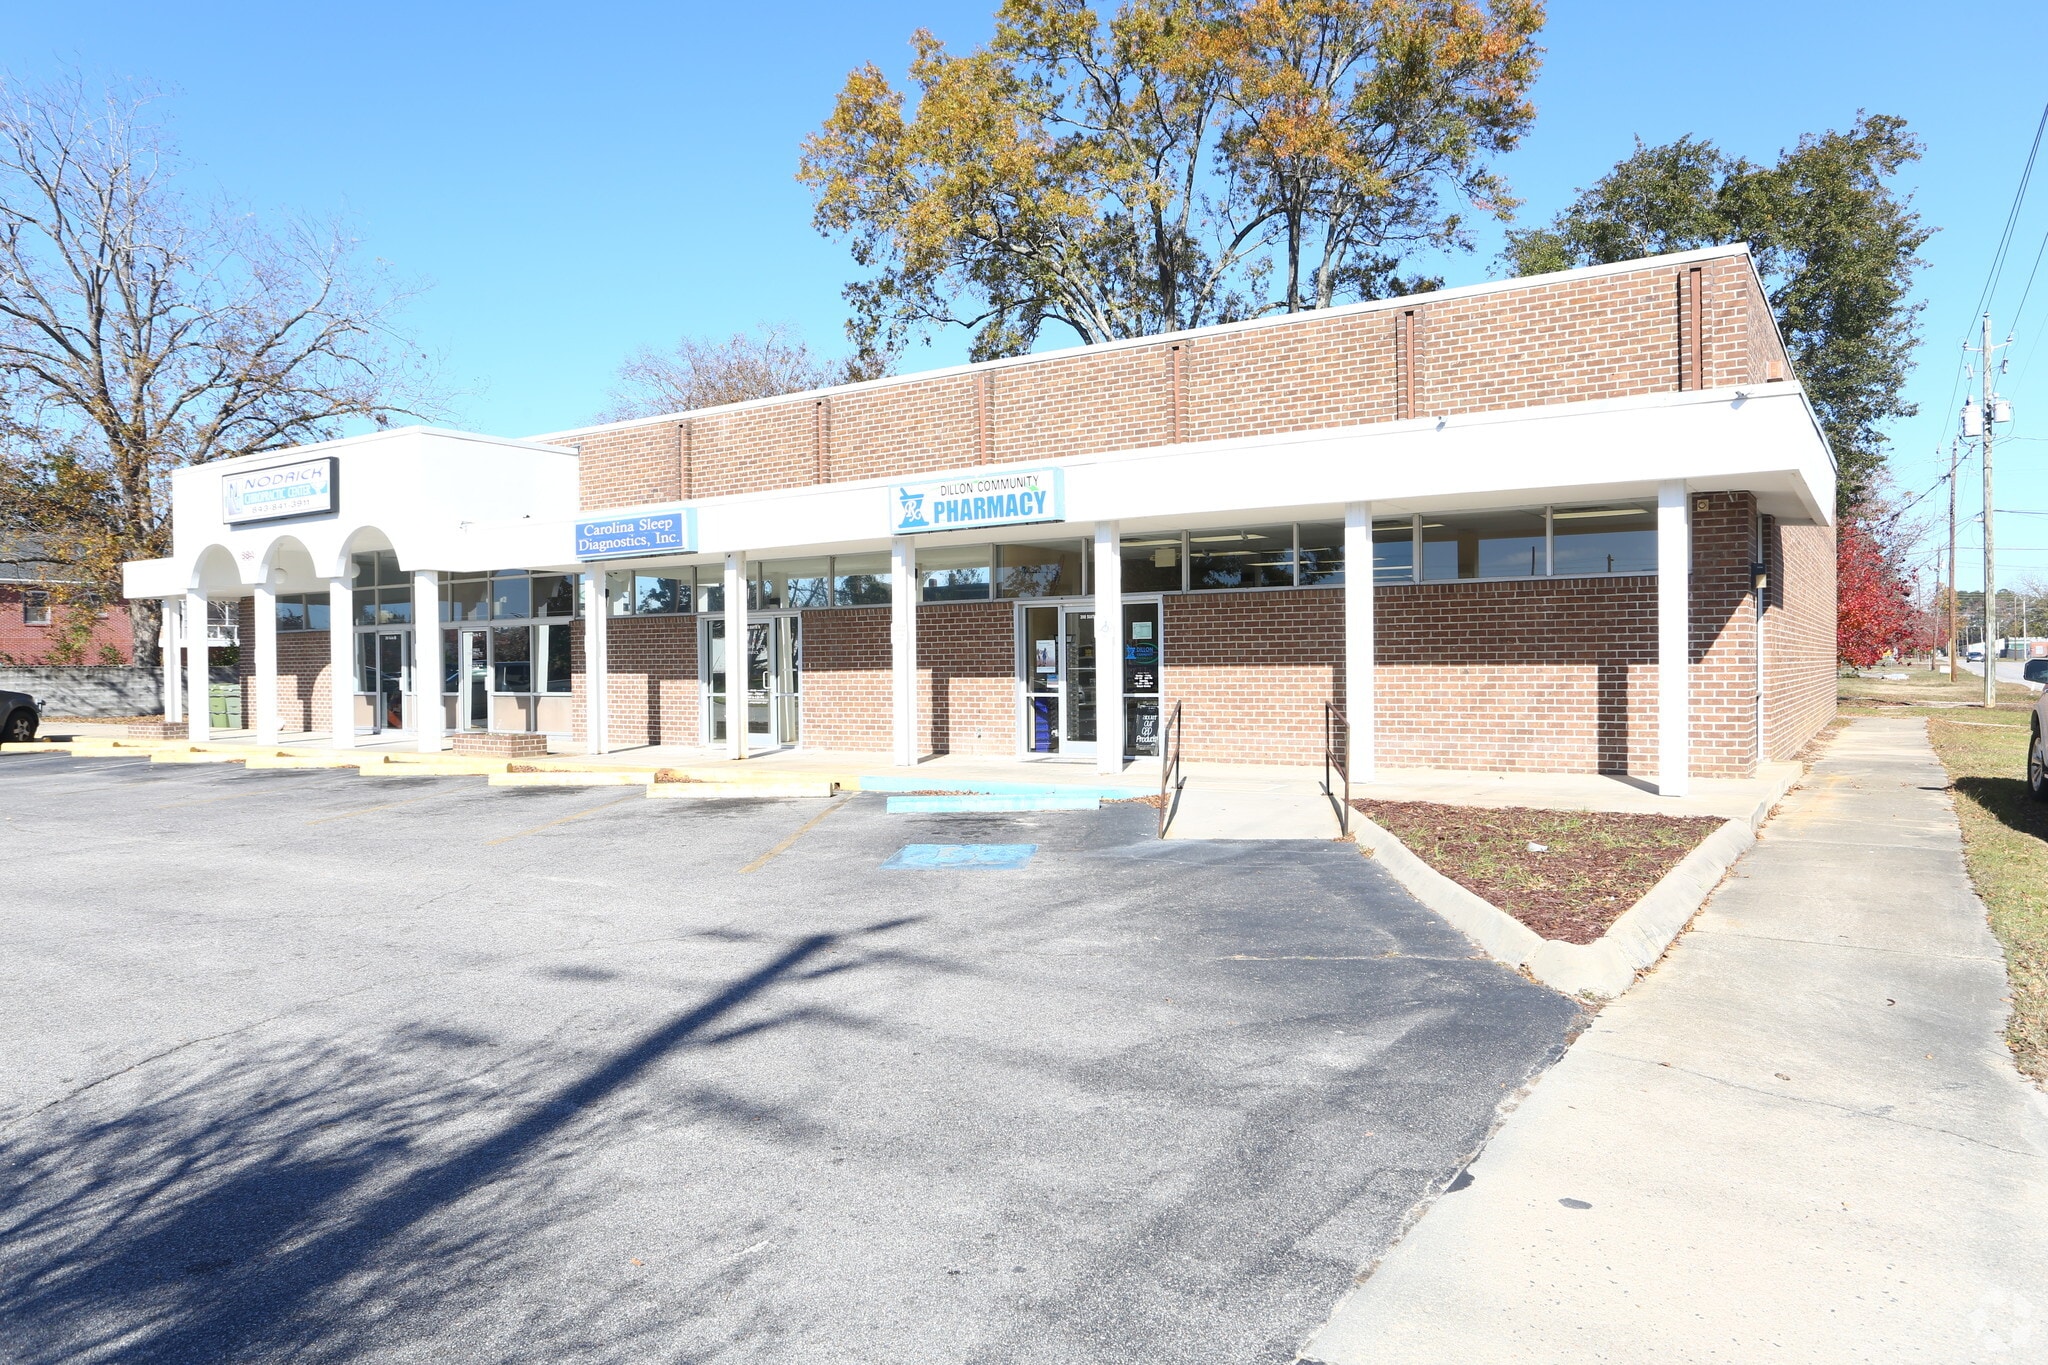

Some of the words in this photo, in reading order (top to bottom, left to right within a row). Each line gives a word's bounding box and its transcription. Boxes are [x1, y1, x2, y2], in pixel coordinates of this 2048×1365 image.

[244, 466, 324, 490] NODRICK
[940, 482, 974, 496] DILLON
[977, 475, 1040, 491] COMMUNITY
[933, 490, 1047, 524] PHARMACY
[583, 521, 635, 537] Carolina
[639, 518, 673, 531] Sleep
[578, 534, 651, 552] Diagnostics,
[655, 531, 680, 544] Inc.
